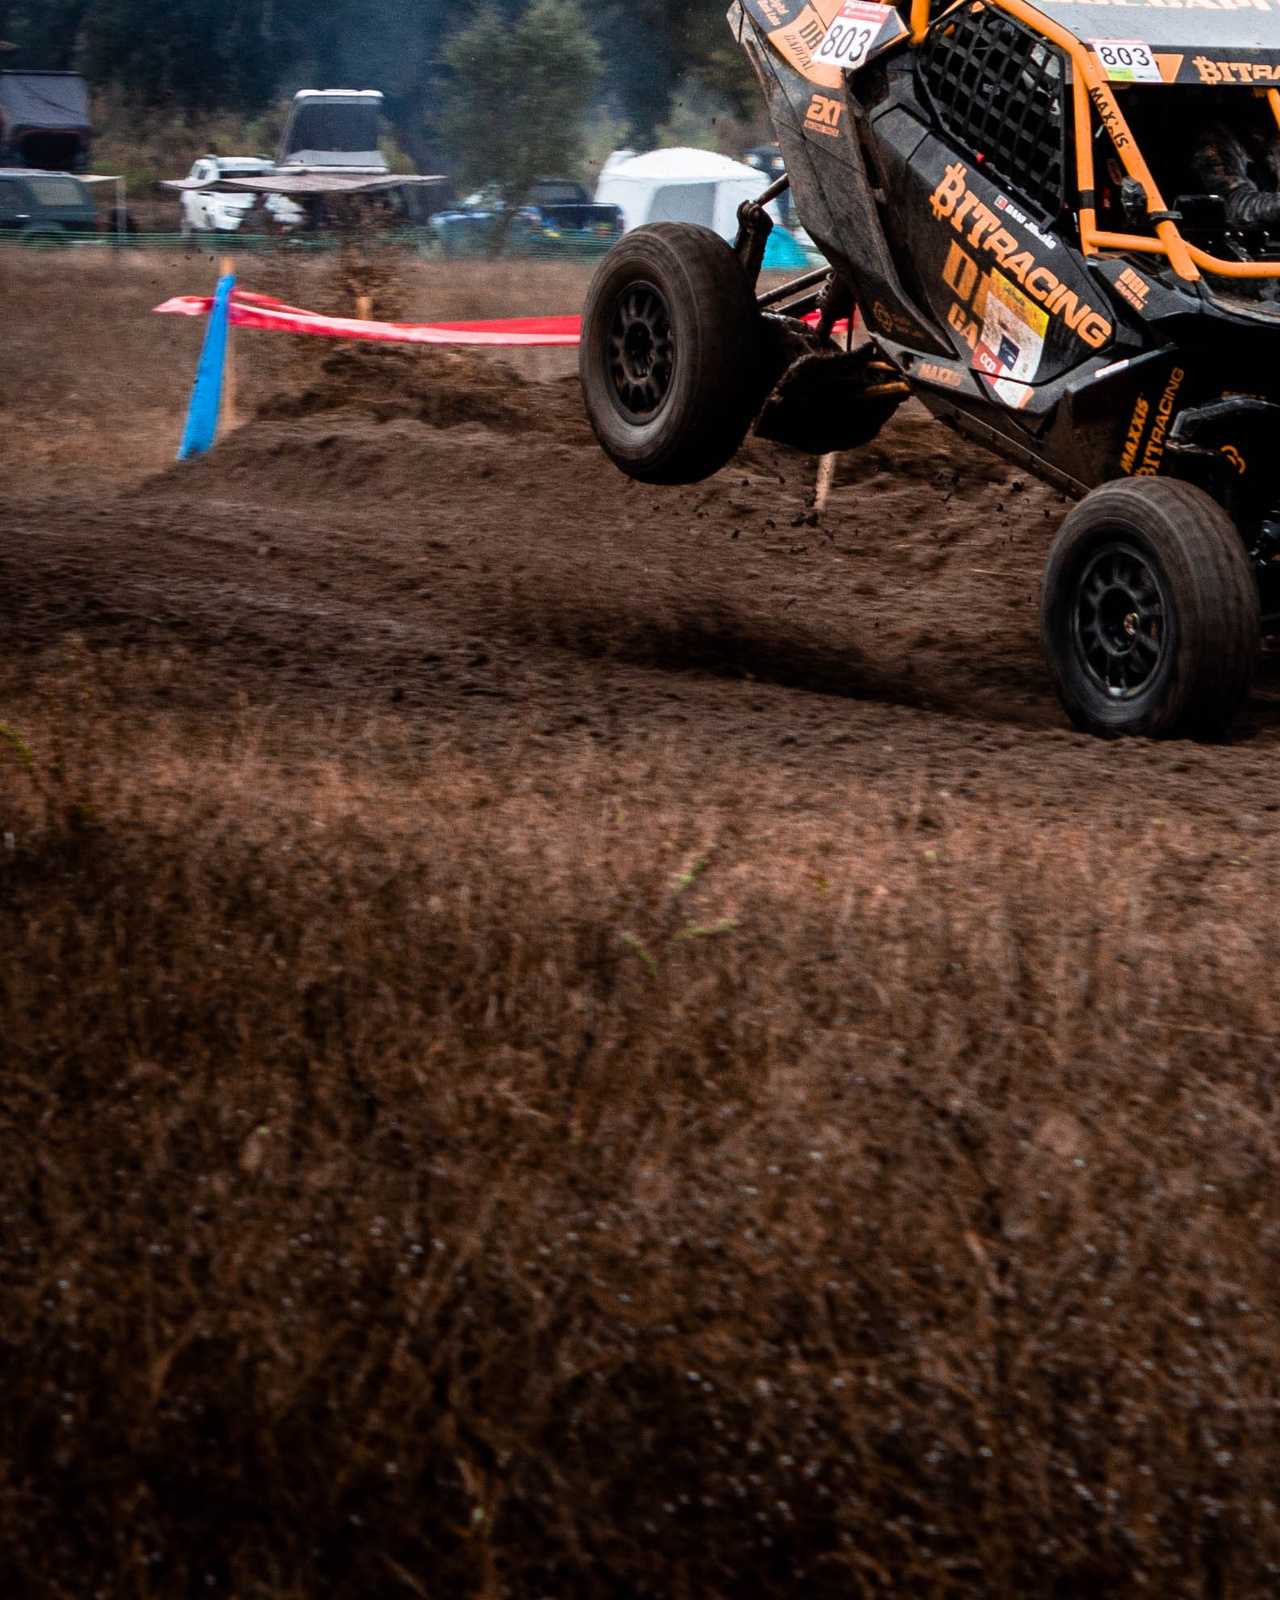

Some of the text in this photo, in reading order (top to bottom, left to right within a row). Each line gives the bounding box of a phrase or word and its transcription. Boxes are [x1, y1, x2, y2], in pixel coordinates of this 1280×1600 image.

[820, 24, 872, 62] 803
[1100, 46, 1150, 67] 803
[929, 162, 1112, 349] BITRACING
[1119, 397, 1150, 475] MAXXIS
[1134, 366, 1185, 477] BITRACING
